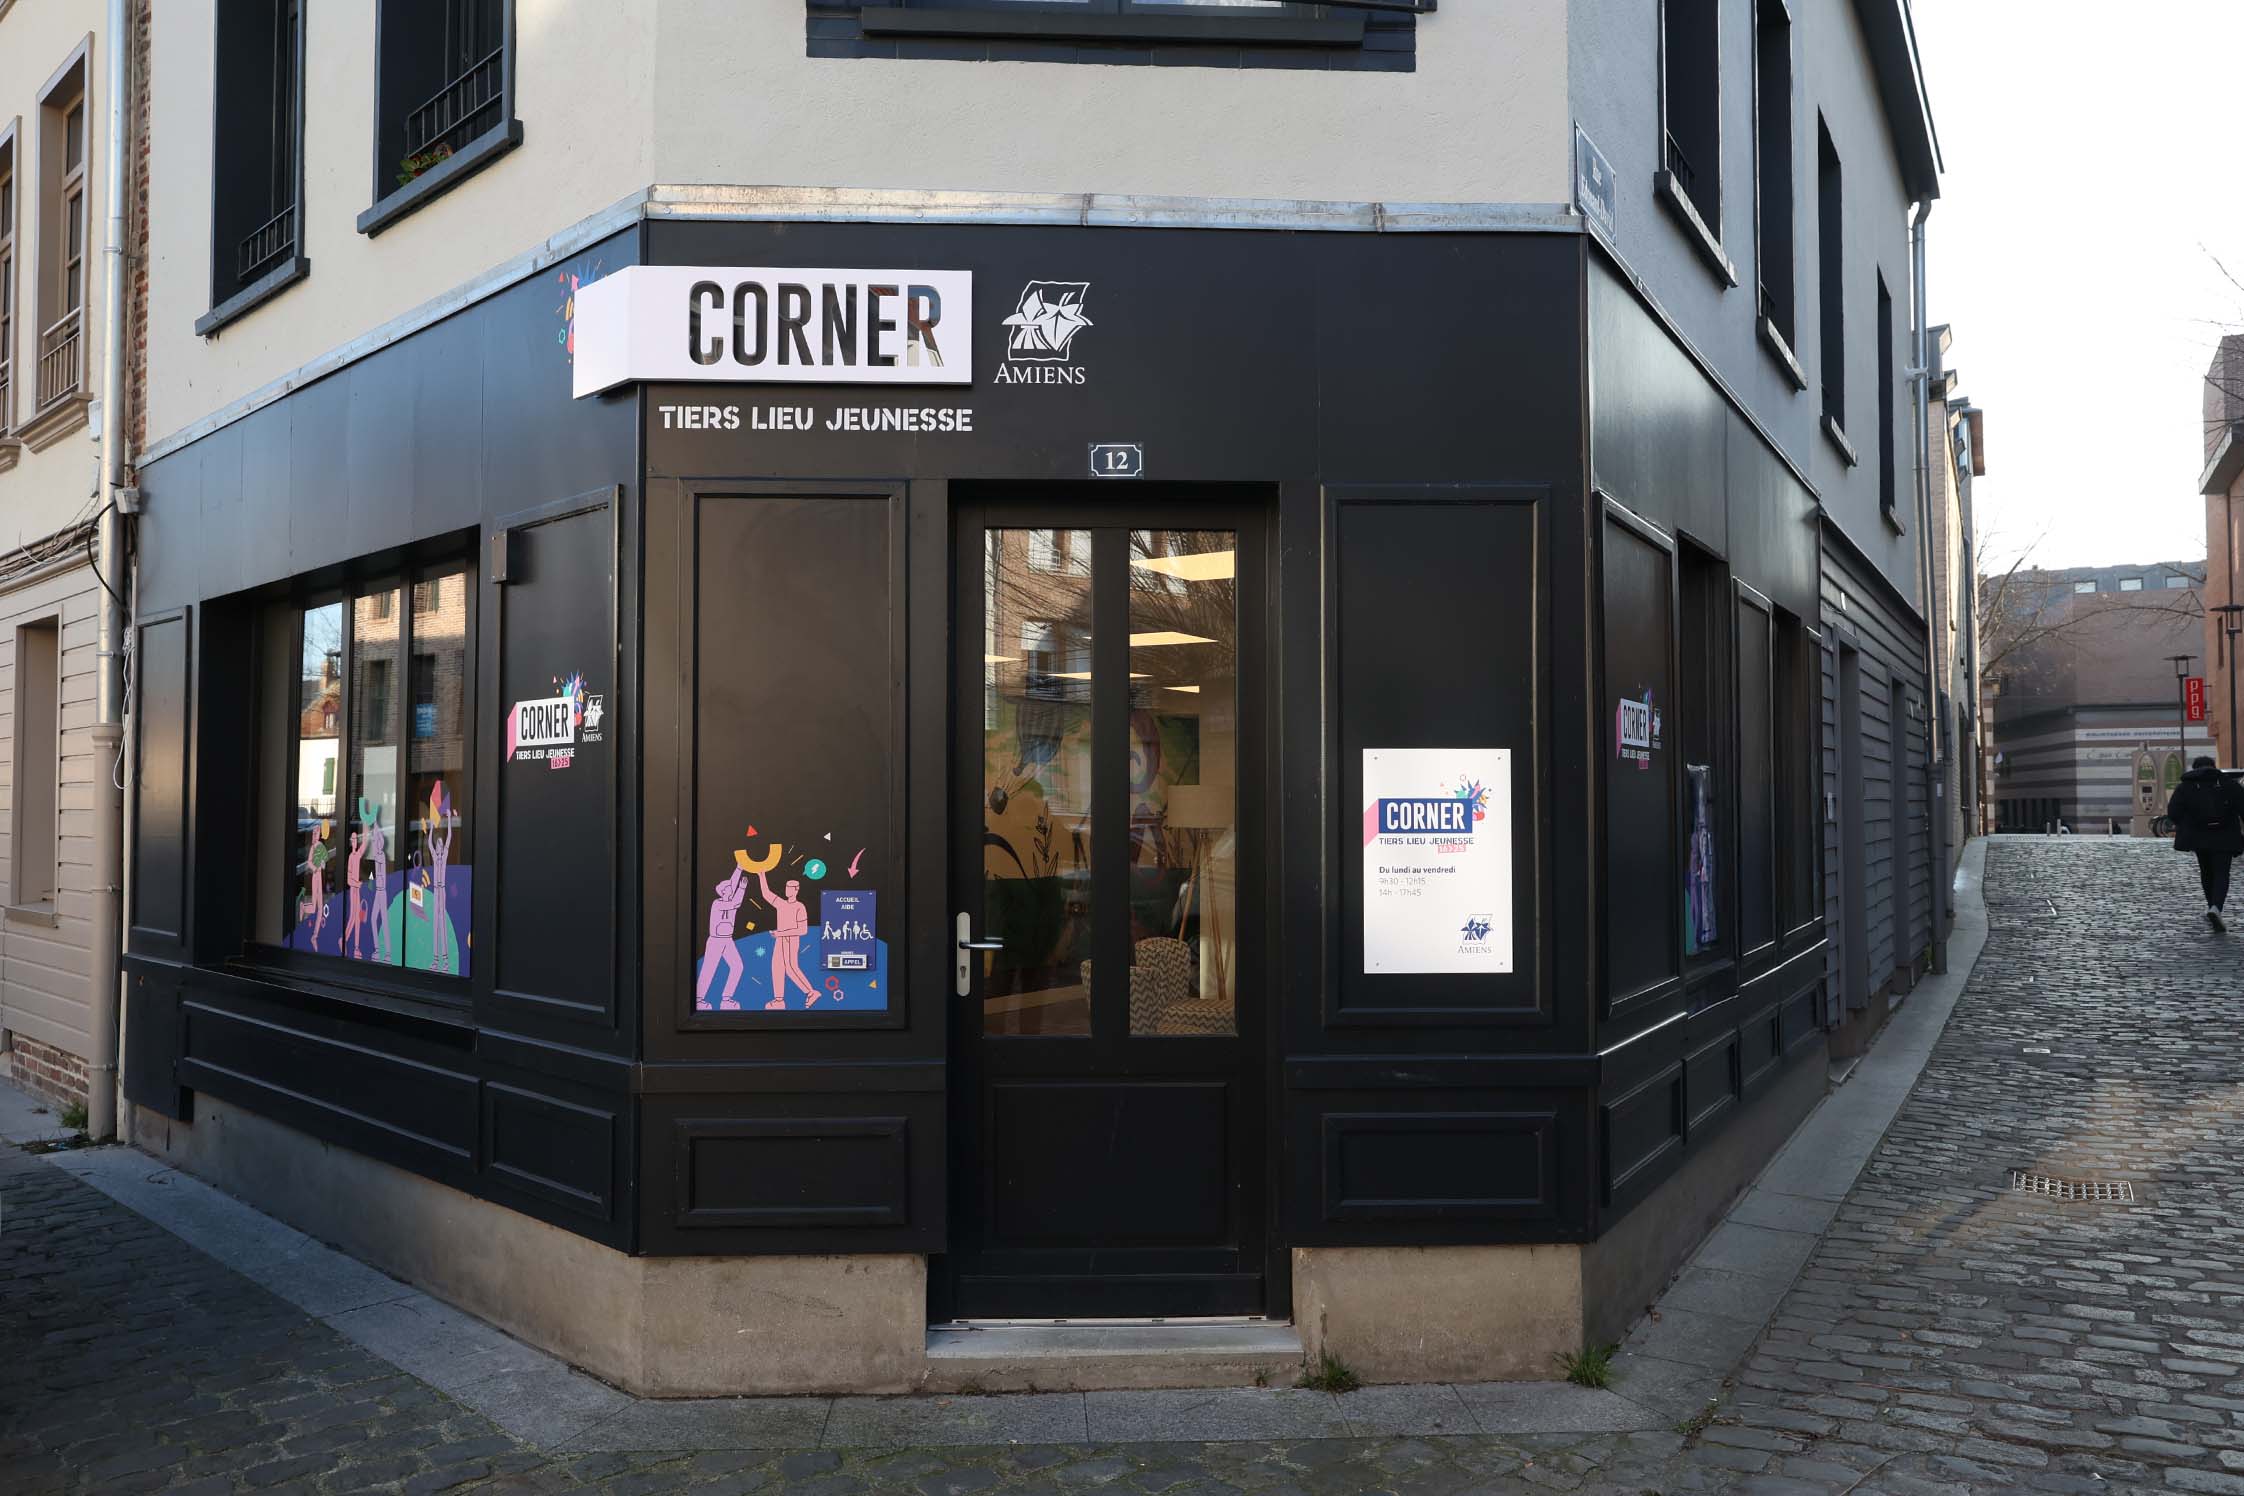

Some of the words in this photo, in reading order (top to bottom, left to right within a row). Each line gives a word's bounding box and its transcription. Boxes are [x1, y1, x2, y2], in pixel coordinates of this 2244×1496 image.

[688, 280, 945, 368] CORNER
[659, 405, 740, 430] TIERS
[751, 406, 813, 431] LIEU
[826, 408, 973, 432] JEUNESSE
[1104, 452, 1128, 471] 12
[521, 703, 569, 741] CORNER
[1623, 705, 1647, 741] CORNER
[516, 750, 531, 761] TIERS
[532, 749, 545, 760] LIEU
[546, 748, 575, 759] JEUNESSE
[1386, 801, 1465, 830] CORNER
[1379, 837, 1404, 845] TIERS
[1406, 837, 1426, 845] LIEU
[1429, 837, 1475, 845] JEUNESSE
